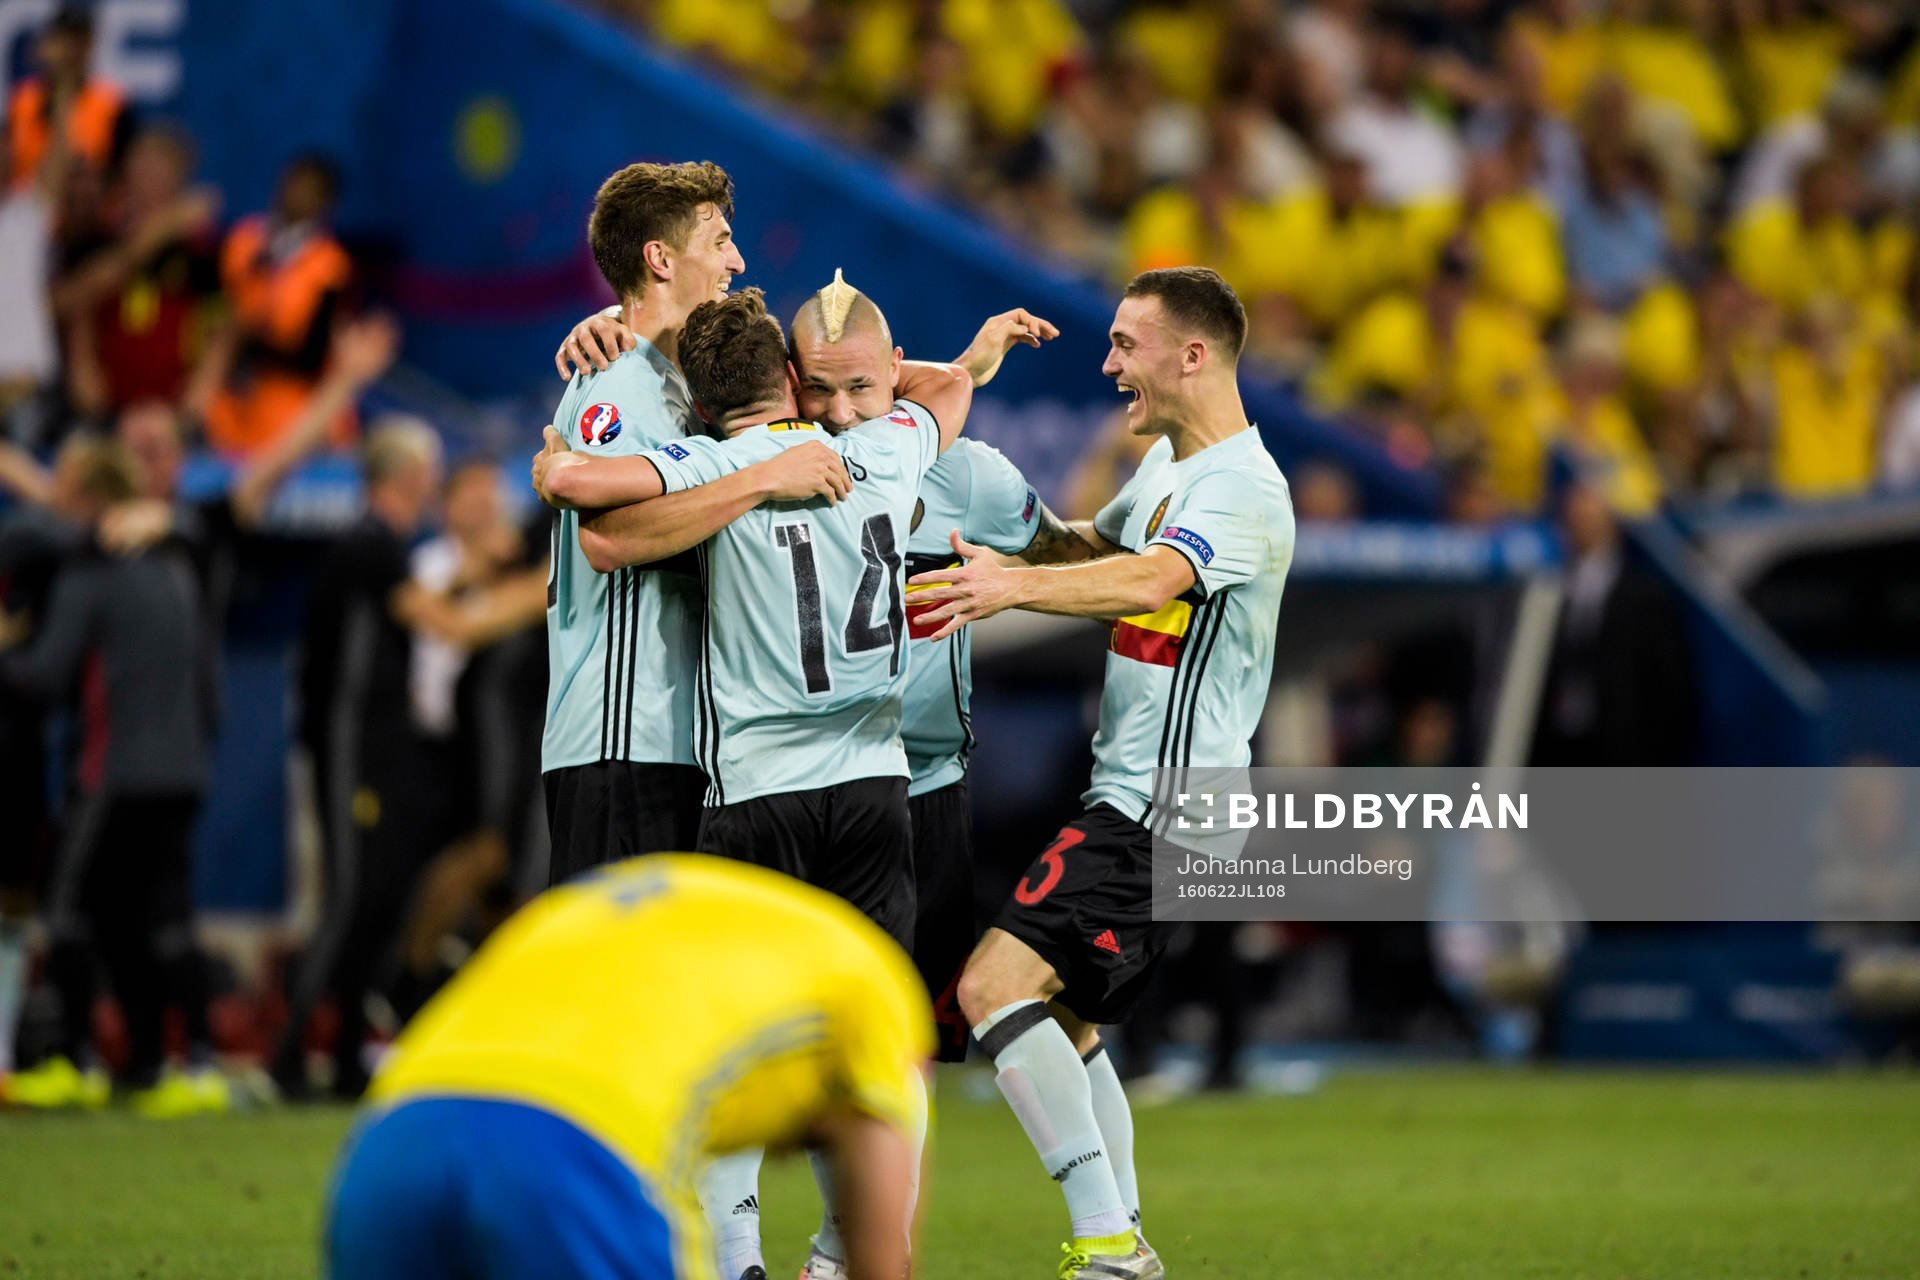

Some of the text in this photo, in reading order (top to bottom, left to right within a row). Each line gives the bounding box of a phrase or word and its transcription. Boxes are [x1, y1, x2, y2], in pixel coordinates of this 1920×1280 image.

[841, 455, 868, 483] S
[1177, 530, 1213, 562] RESPECT
[772, 510, 905, 695] 14
[1014, 826, 1087, 905] 3
